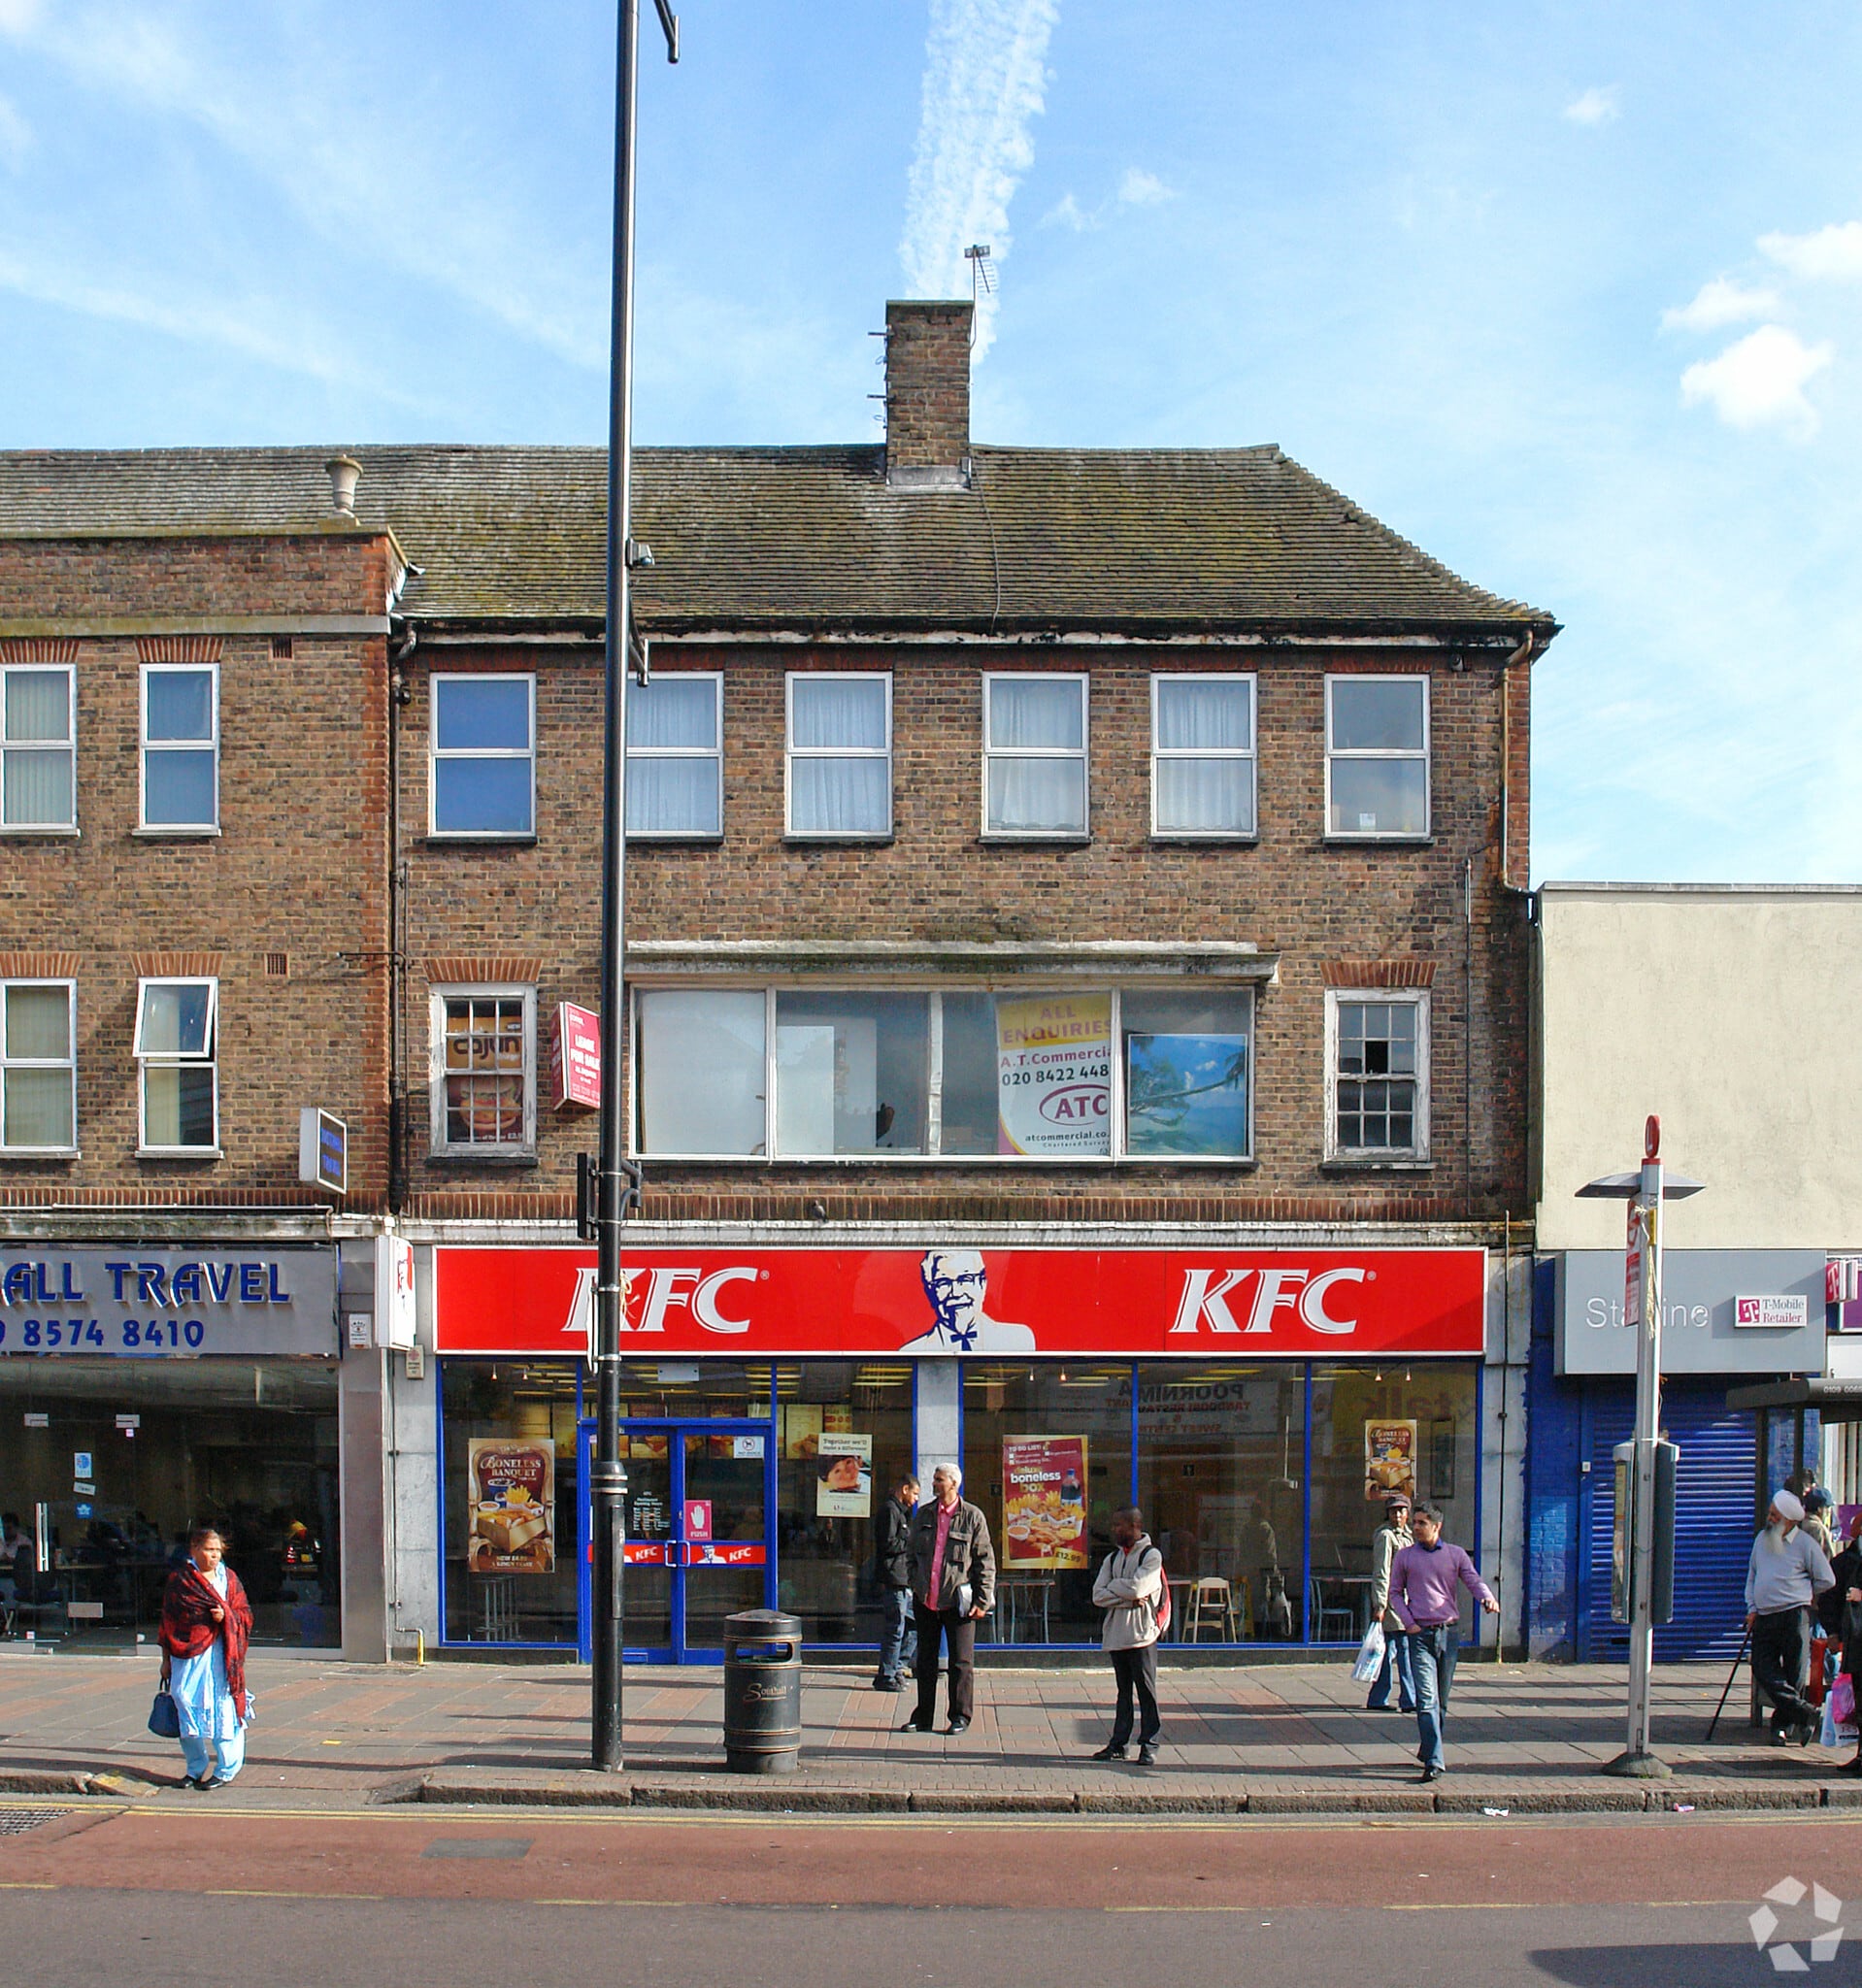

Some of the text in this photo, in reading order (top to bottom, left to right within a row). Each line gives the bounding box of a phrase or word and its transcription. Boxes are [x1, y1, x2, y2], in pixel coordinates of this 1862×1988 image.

[1041, 1004, 1077, 1020] ALL
[1003, 1019, 1111, 1044] ENQUIRIES
[1002, 1072, 1031, 1086] 020
[1036, 1068, 1075, 1082] 8422
[1054, 1094, 1108, 1119] ATC
[105, 1261, 290, 1308] TRAVEL
[560, 1267, 758, 1334] KFC
[1167, 1267, 1365, 1335] KFC
[1762, 1299, 1805, 1310] T-Mobile
[1585, 1297, 1709, 1328] Stine
[1762, 1312, 1803, 1323] Retailer
[23, 1319, 104, 1347] 8574
[122, 1319, 204, 1347] 8410
[480, 1455, 542, 1469] BONELESS
[491, 1468, 537, 1477] BANQUET
[1010, 1472, 1061, 1483] boneless
[1019, 1482, 1046, 1493] box
[635, 1546, 658, 1561] KFC
[729, 1547, 752, 1562] KFC
